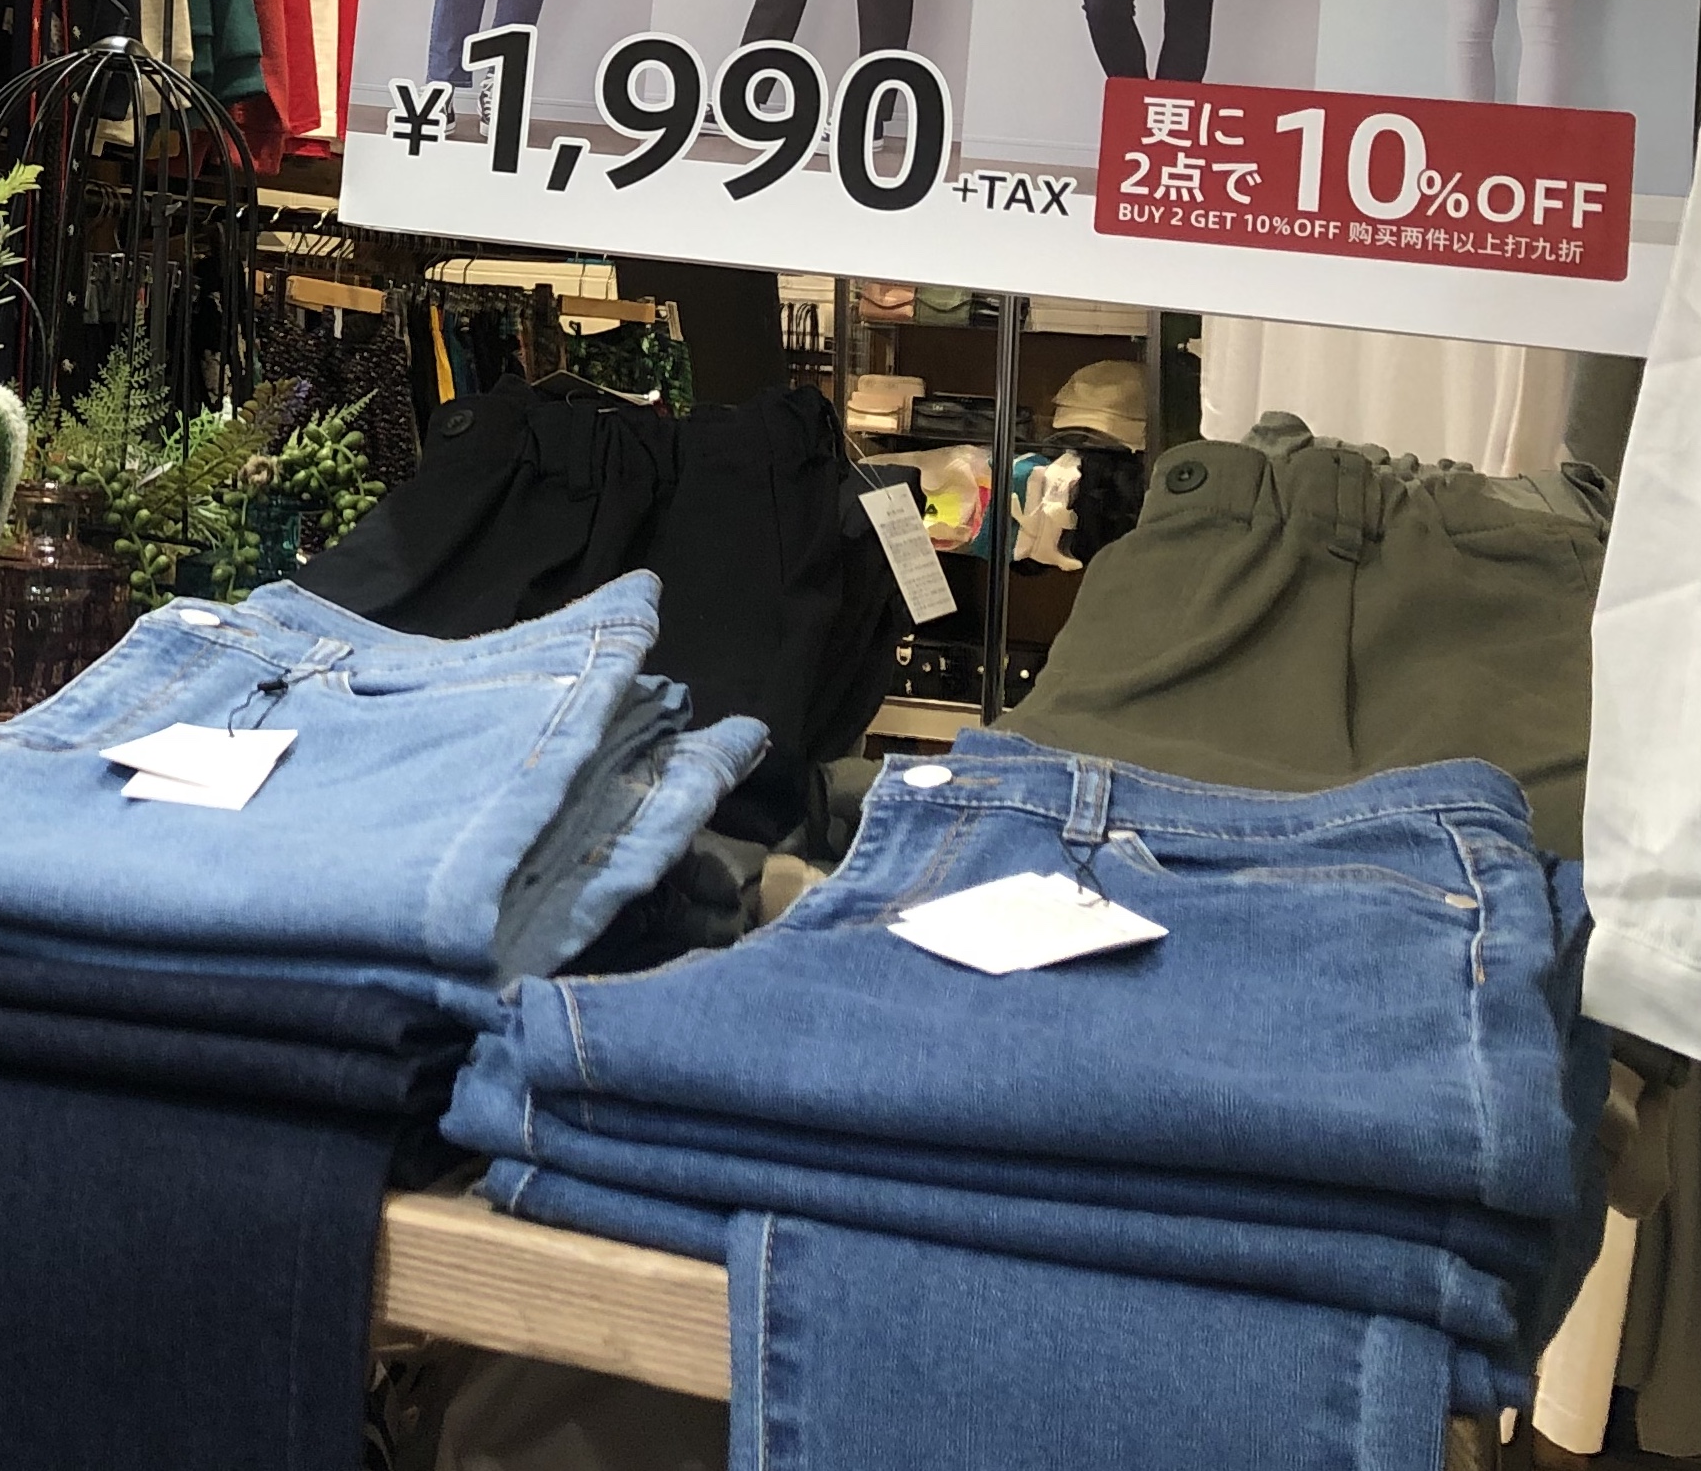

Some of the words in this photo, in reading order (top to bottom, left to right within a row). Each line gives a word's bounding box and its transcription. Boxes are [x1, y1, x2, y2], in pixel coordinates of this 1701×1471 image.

[1140, 95, 1245, 148] 更に
[951, 174, 1074, 217] +TAX
[1118, 202, 1165, 224] BUY
[1169, 207, 1183, 226] 2
[1190, 210, 1237, 230] GET
[1243, 214, 1342, 241] 10%OFF
[1348, 221, 1584, 264] 购买两件以上打九折
